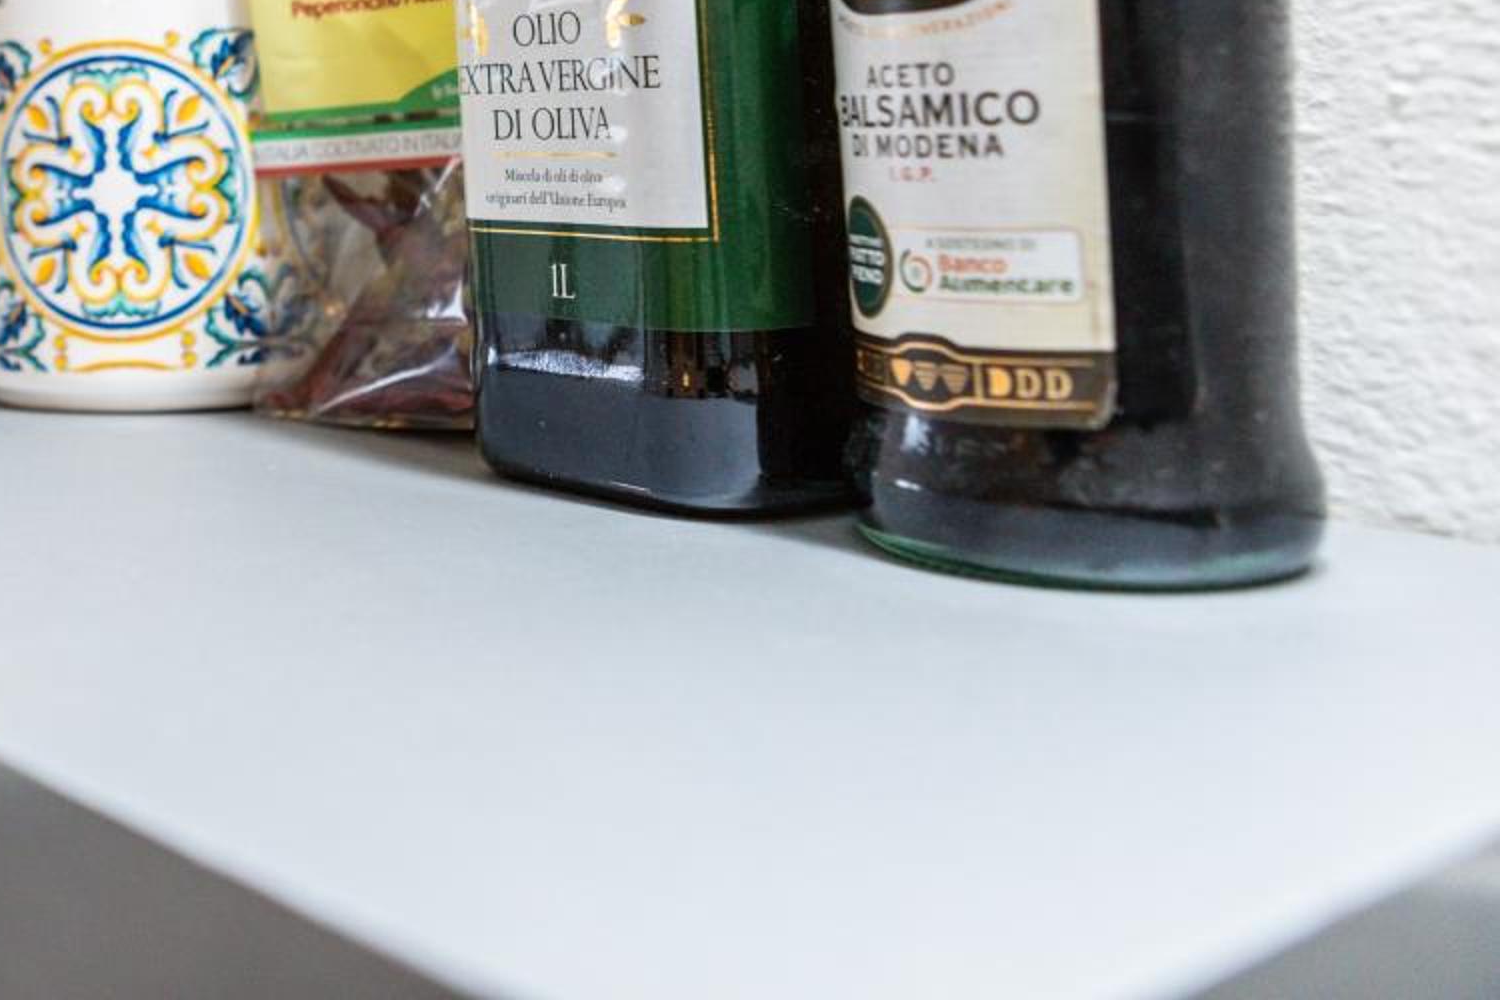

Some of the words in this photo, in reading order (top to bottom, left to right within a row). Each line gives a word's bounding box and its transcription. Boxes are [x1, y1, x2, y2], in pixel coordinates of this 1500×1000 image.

[513, 10, 581, 47] OLIO
[538, 55, 661, 92] VERGINE
[867, 62, 955, 89] ACETO
[494, 109, 522, 142] DI
[532, 105, 611, 142] OLIVA
[840, 90, 1040, 129] BALSAMICO
[875, 133, 1004, 159] MODENA
[551, 264, 576, 299] 1L
[937, 254, 1008, 274] Banco
